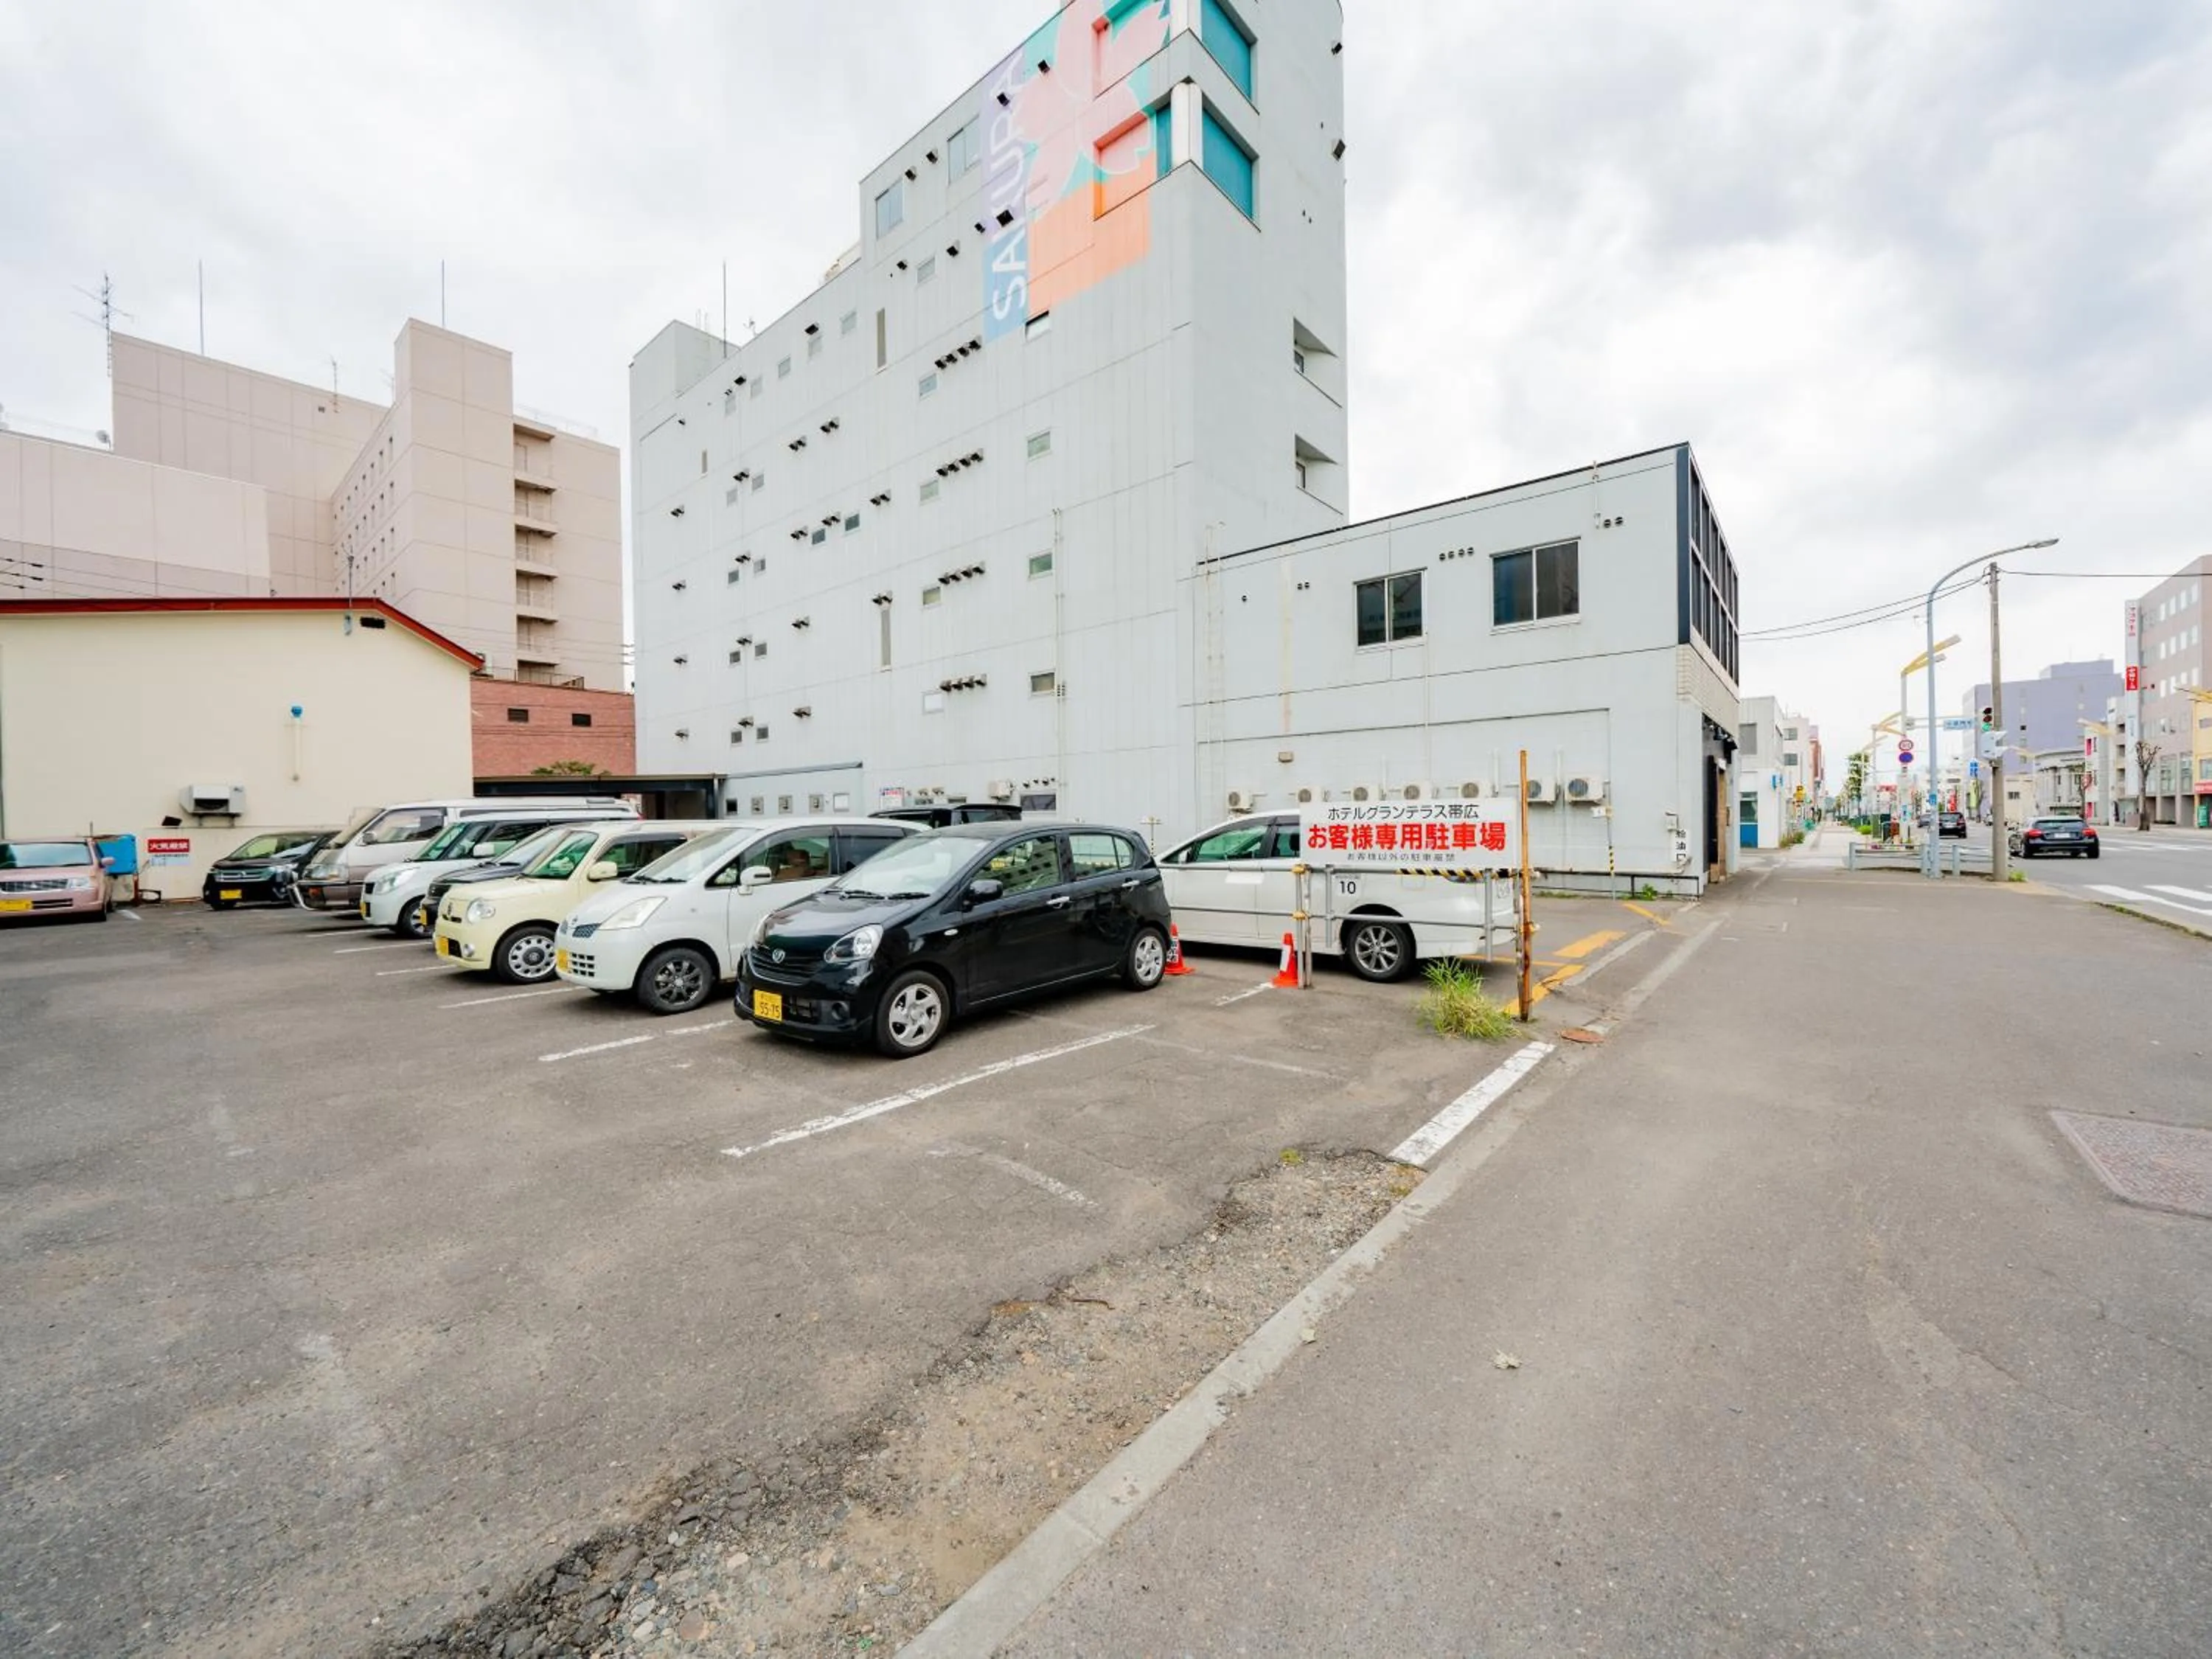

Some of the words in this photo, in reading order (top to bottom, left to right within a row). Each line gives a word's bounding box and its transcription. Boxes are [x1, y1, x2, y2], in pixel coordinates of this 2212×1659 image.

[1328, 804, 1479, 821] ホテルグランテラス帯広
[1307, 822, 1506, 850] お客様専用駐車場
[1340, 880, 1356, 894] 10
